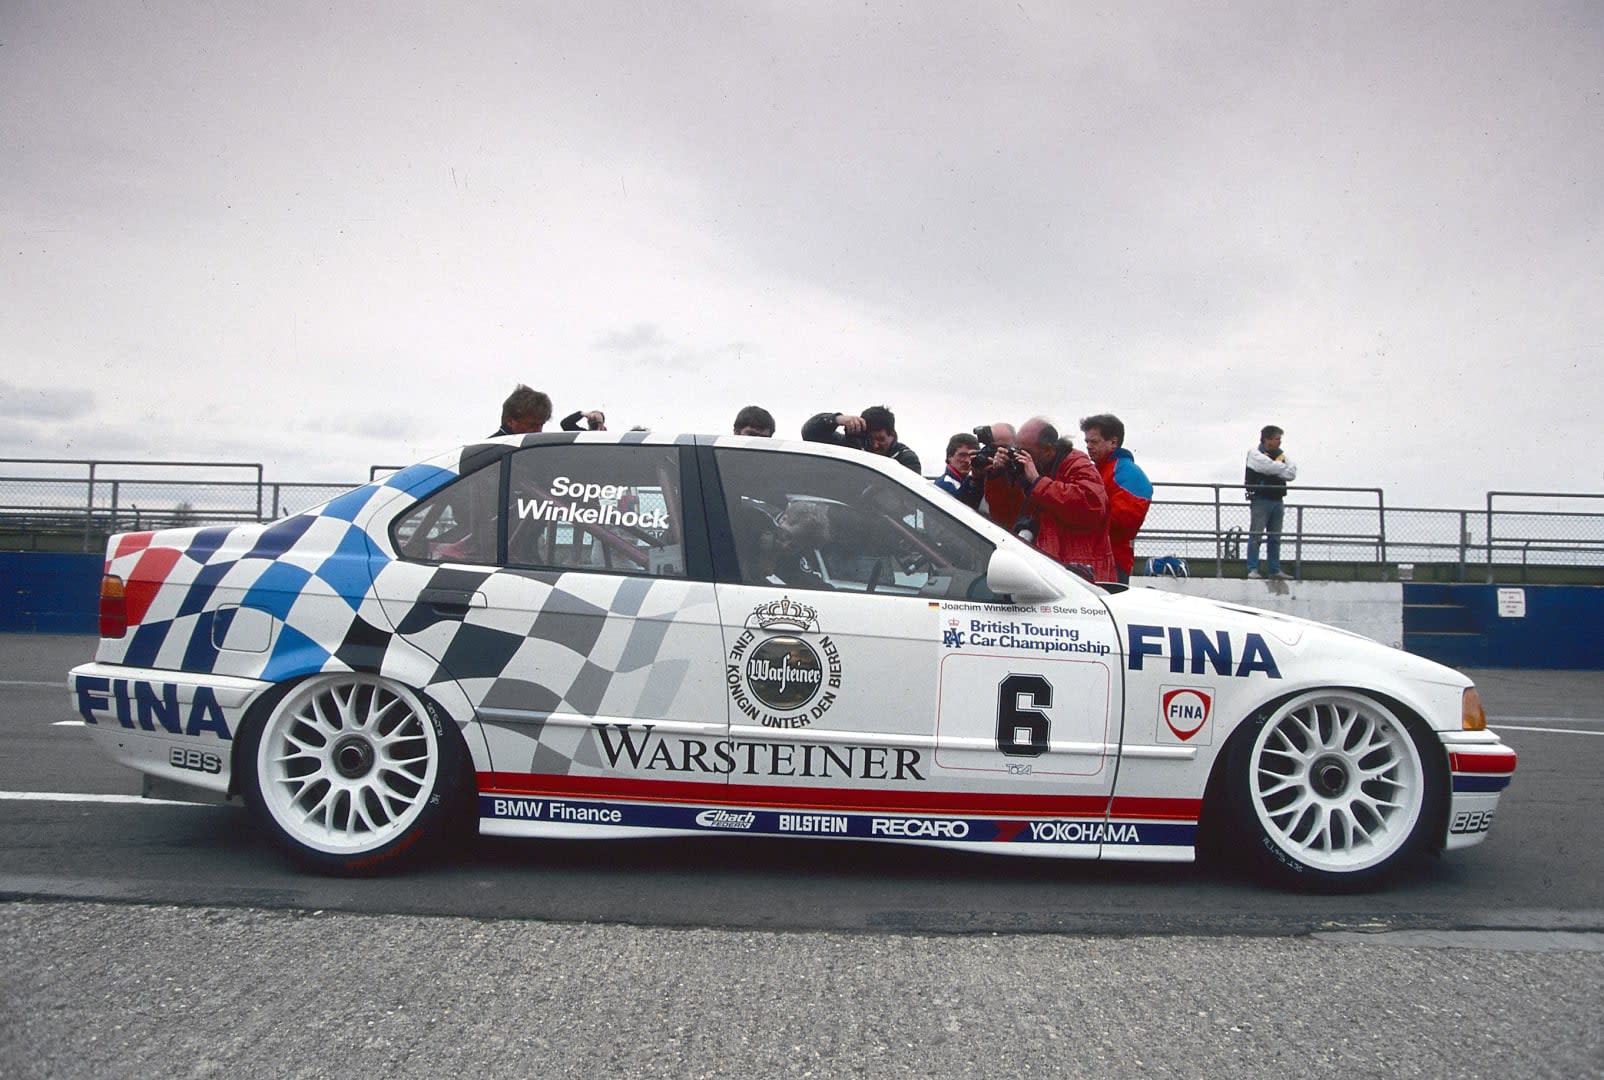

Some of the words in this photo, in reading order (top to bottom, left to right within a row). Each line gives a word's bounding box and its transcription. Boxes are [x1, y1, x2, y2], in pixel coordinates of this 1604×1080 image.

[551, 477, 628, 502] Soper
[517, 499, 670, 529] Winkelhock
[942, 603, 981, 612] Joachim
[984, 604, 1037, 613] Winkelhock
[1053, 606, 1077, 614] Steve
[943, 627, 966, 648] RAC
[971, 620, 1020, 634] British
[1021, 623, 1079, 641] Touring
[729, 629, 755, 661] EINE
[970, 633, 998, 647] Car
[999, 635, 1111, 656] Championship
[1127, 623, 1282, 679] FINA
[747, 652, 821, 694] Warsteiner
[819, 635, 842, 689] BIEREN
[727, 664, 760, 720] KÖNIGIN
[75, 675, 232, 741] FINA
[810, 691, 836, 720] DEN
[995, 673, 1053, 758] 6
[1170, 704, 1203, 721] FINA
[761, 713, 811, 729] UNTER
[169, 747, 222, 774] BBS
[592, 723, 926, 782] WARSTEINER
[494, 799, 543, 818] BMW
[549, 803, 623, 823] Finance
[696, 810, 756, 827] Eibach
[1450, 811, 1494, 834] BBS
[779, 814, 848, 833] BILSTEIN
[872, 818, 969, 838] RECARO
[1029, 822, 1140, 843] YOKOHAMA
